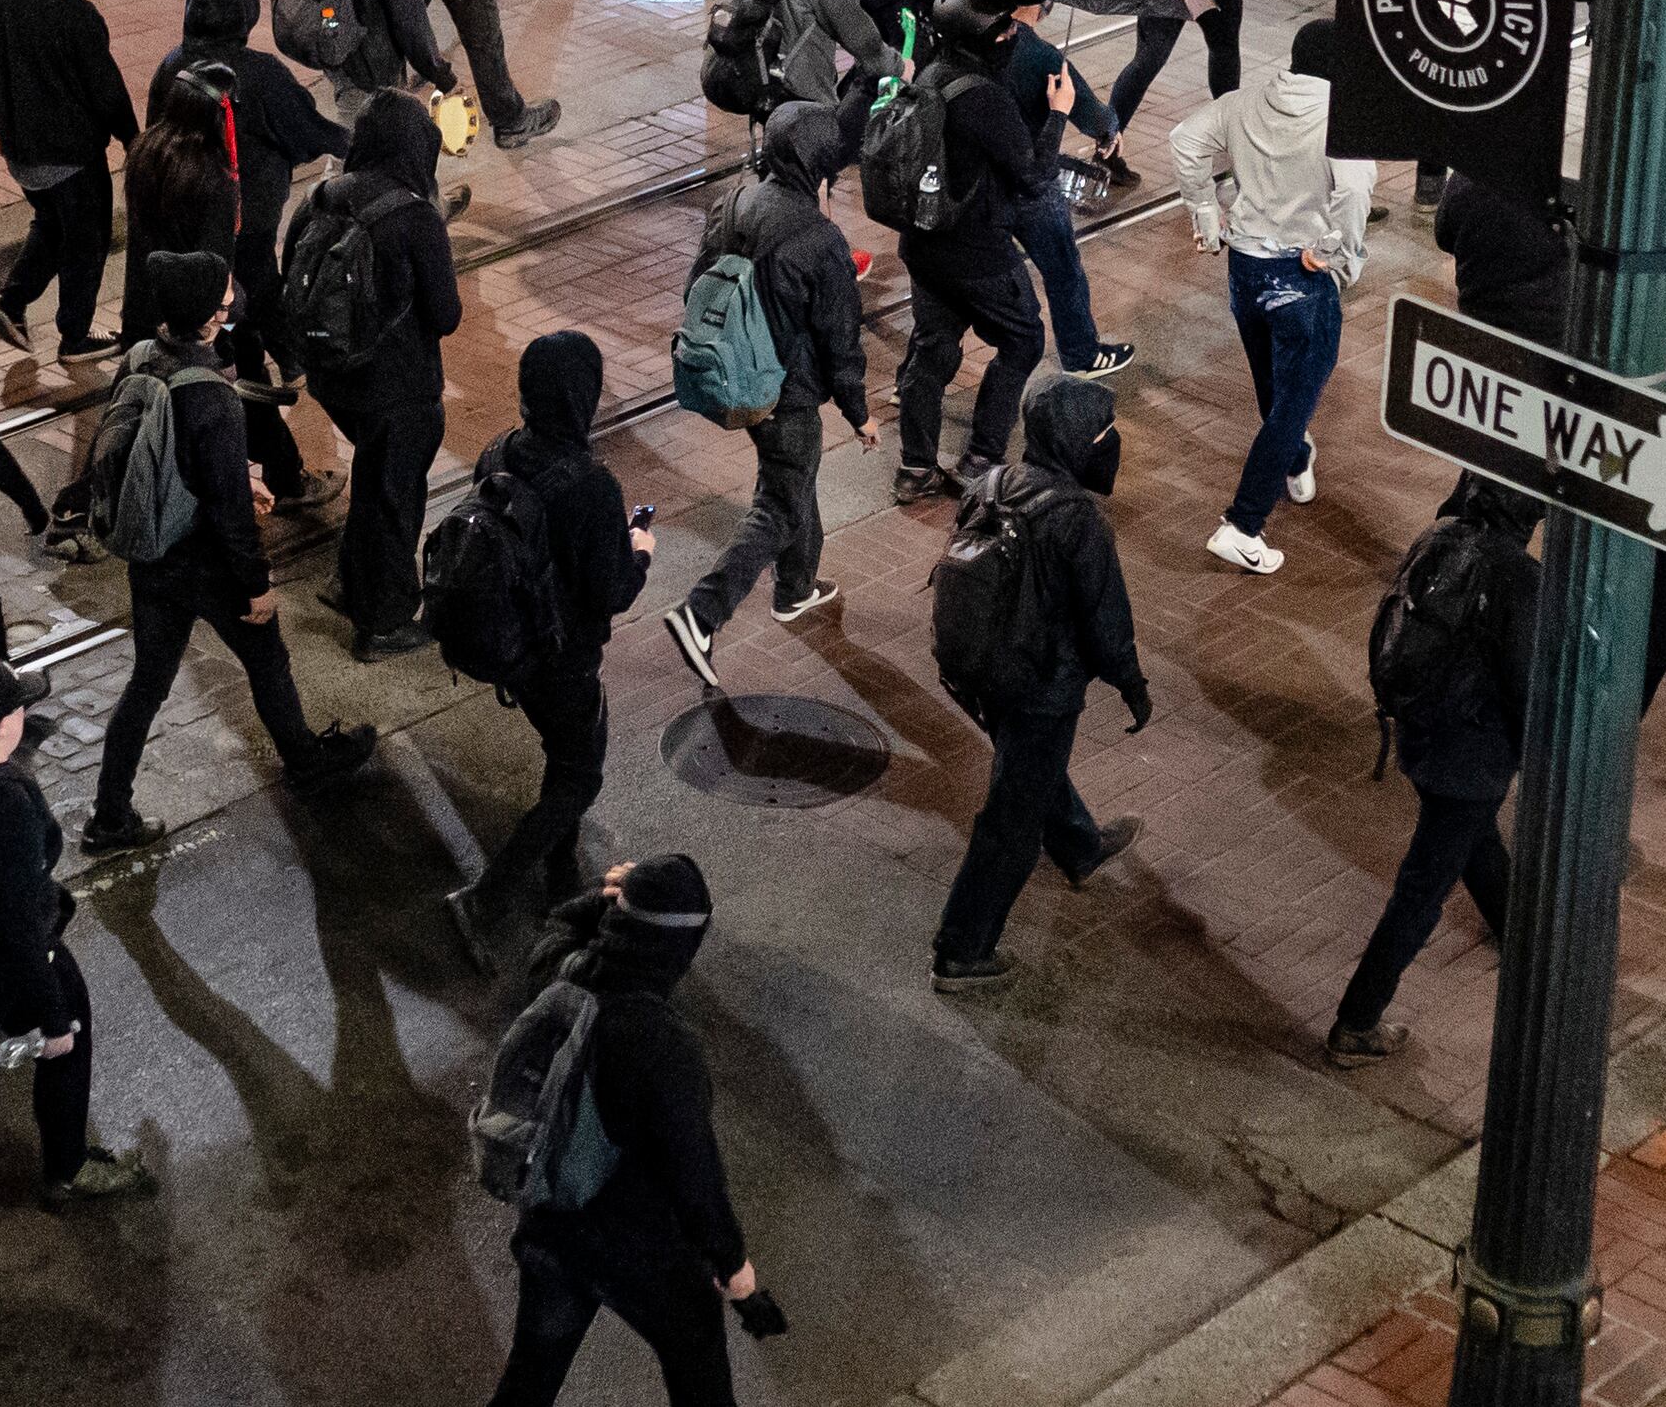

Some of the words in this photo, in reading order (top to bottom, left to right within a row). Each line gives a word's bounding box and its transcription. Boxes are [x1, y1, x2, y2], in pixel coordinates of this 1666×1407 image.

[1408, 48, 1489, 88] PORTLAND
[1426, 355, 1523, 440] ONE
[1543, 399, 1647, 486] WAY
